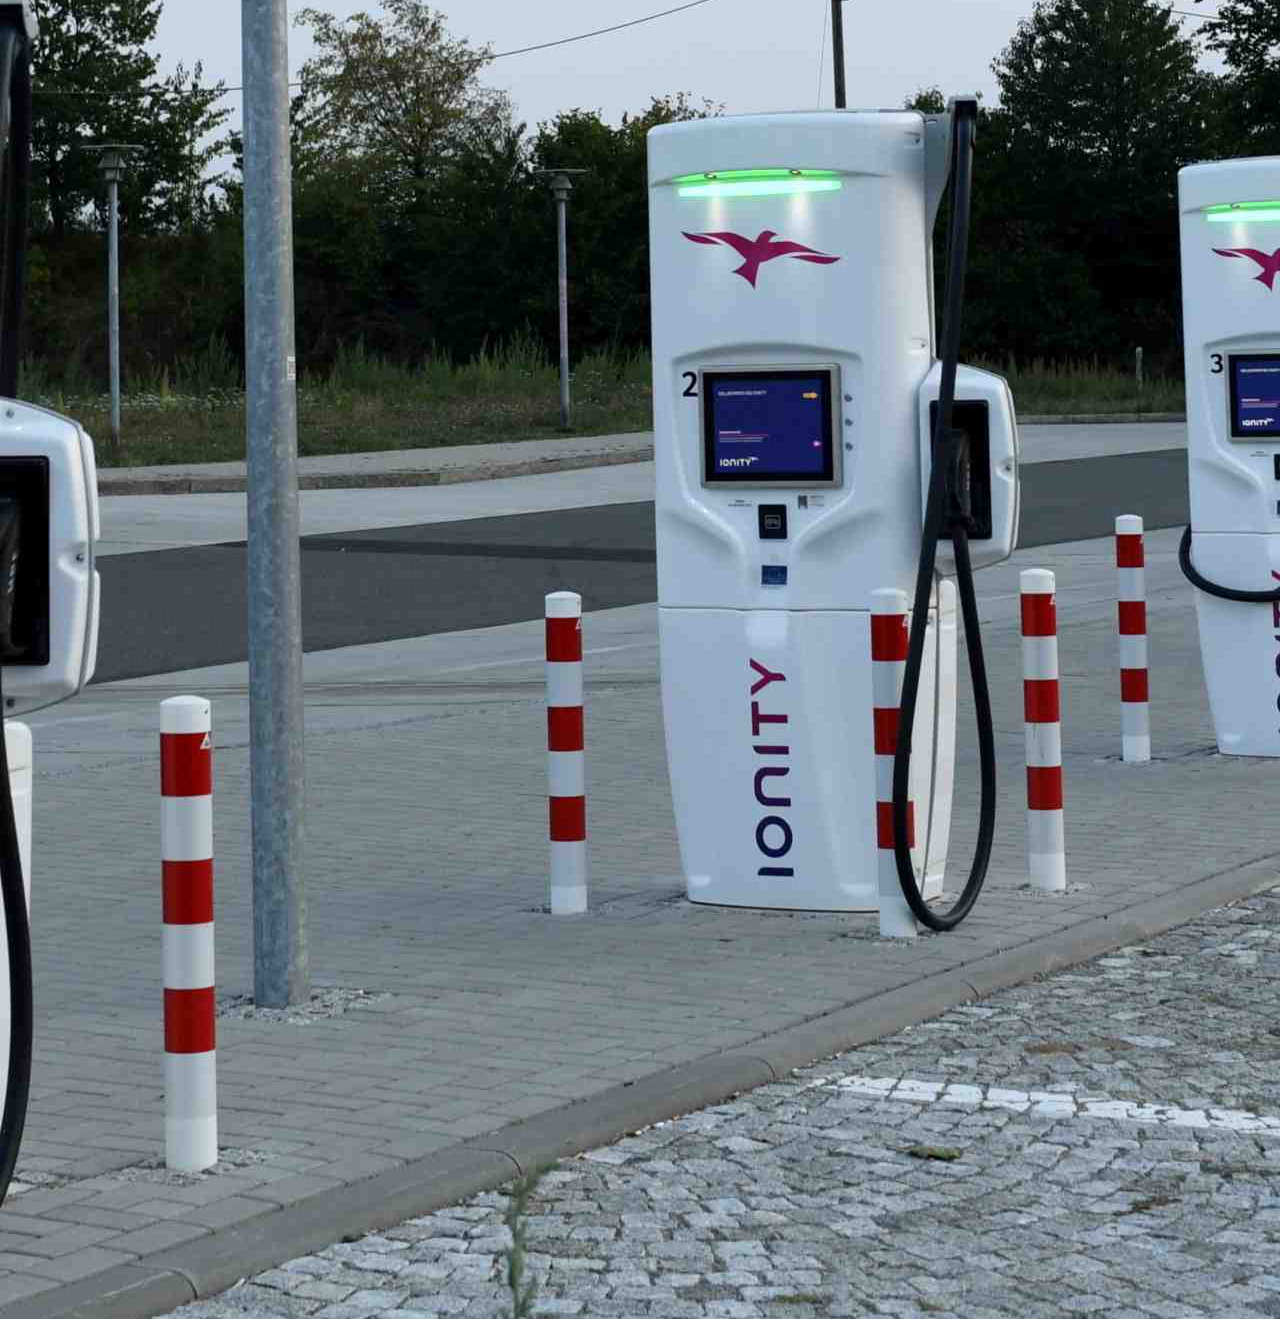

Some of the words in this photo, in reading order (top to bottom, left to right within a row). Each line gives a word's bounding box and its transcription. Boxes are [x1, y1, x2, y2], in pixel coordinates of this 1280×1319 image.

[1210, 353, 1224, 374] 3
[682, 371, 698, 397] 2
[719, 457, 752, 467] IONITY
[749, 658, 795, 877] IONITY
